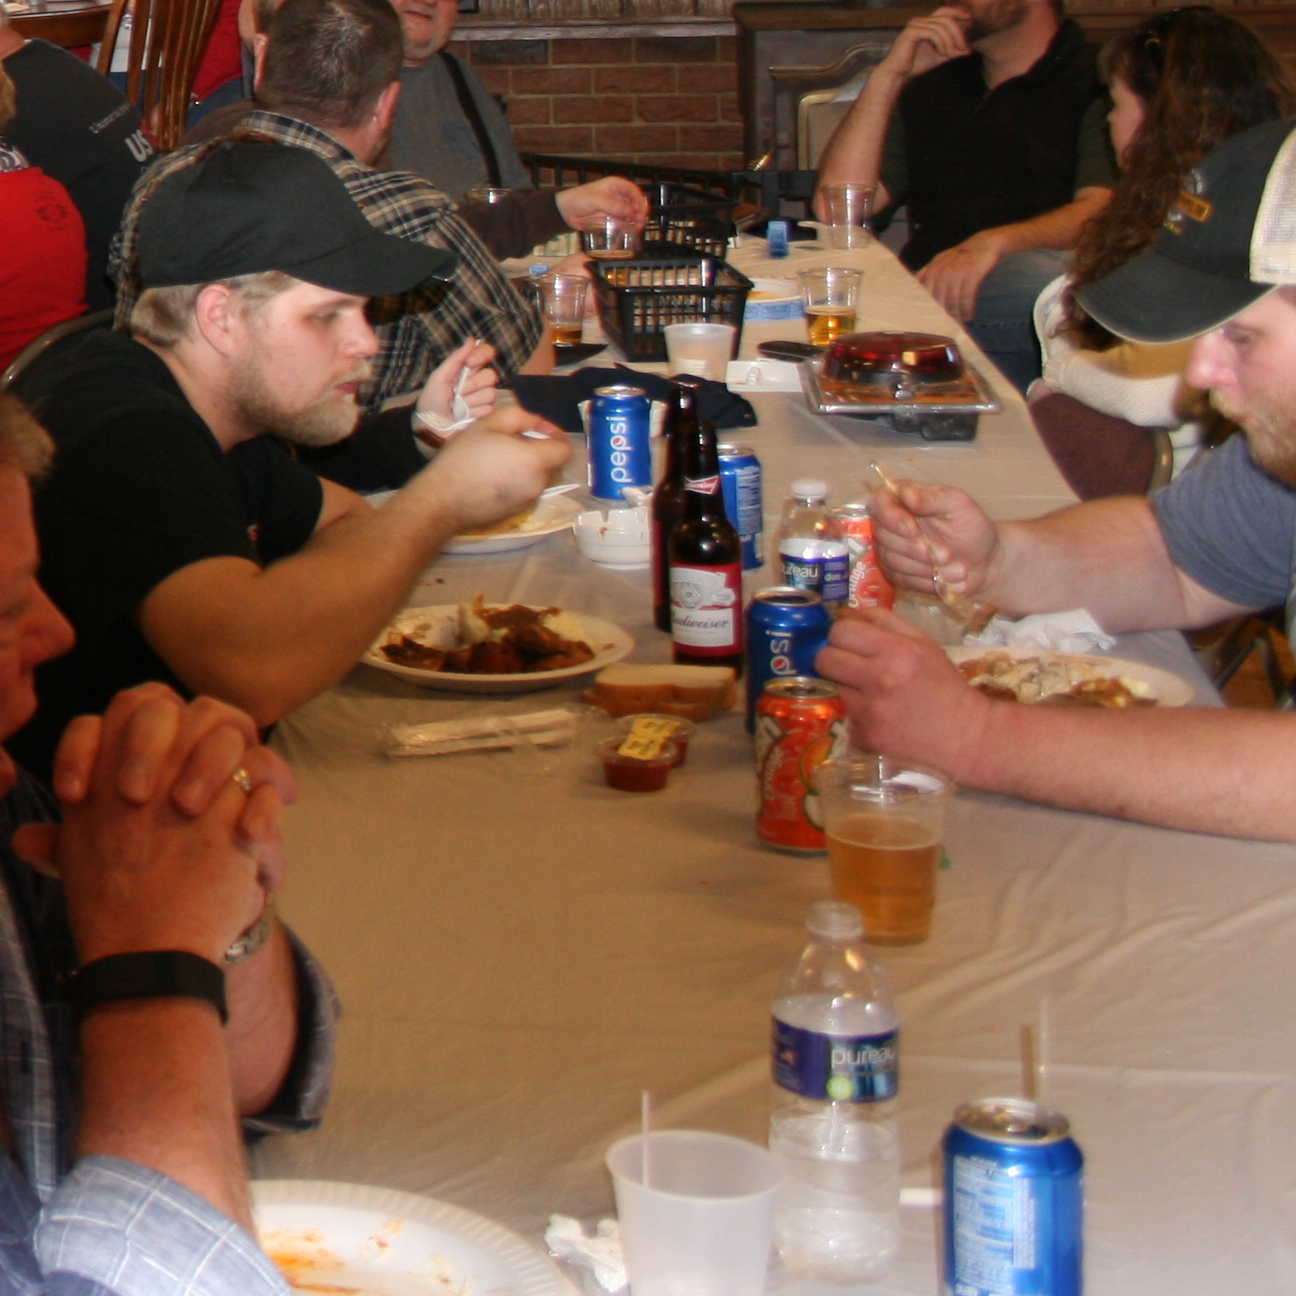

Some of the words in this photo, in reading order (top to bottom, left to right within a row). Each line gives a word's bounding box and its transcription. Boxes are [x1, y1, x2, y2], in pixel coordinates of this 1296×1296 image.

[605, 415, 634, 483] pepsi
[781, 563, 818, 578] ureau
[671, 612, 729, 628] udweiser
[765, 629, 797, 676] psi
[830, 1045, 895, 1069] pureau
